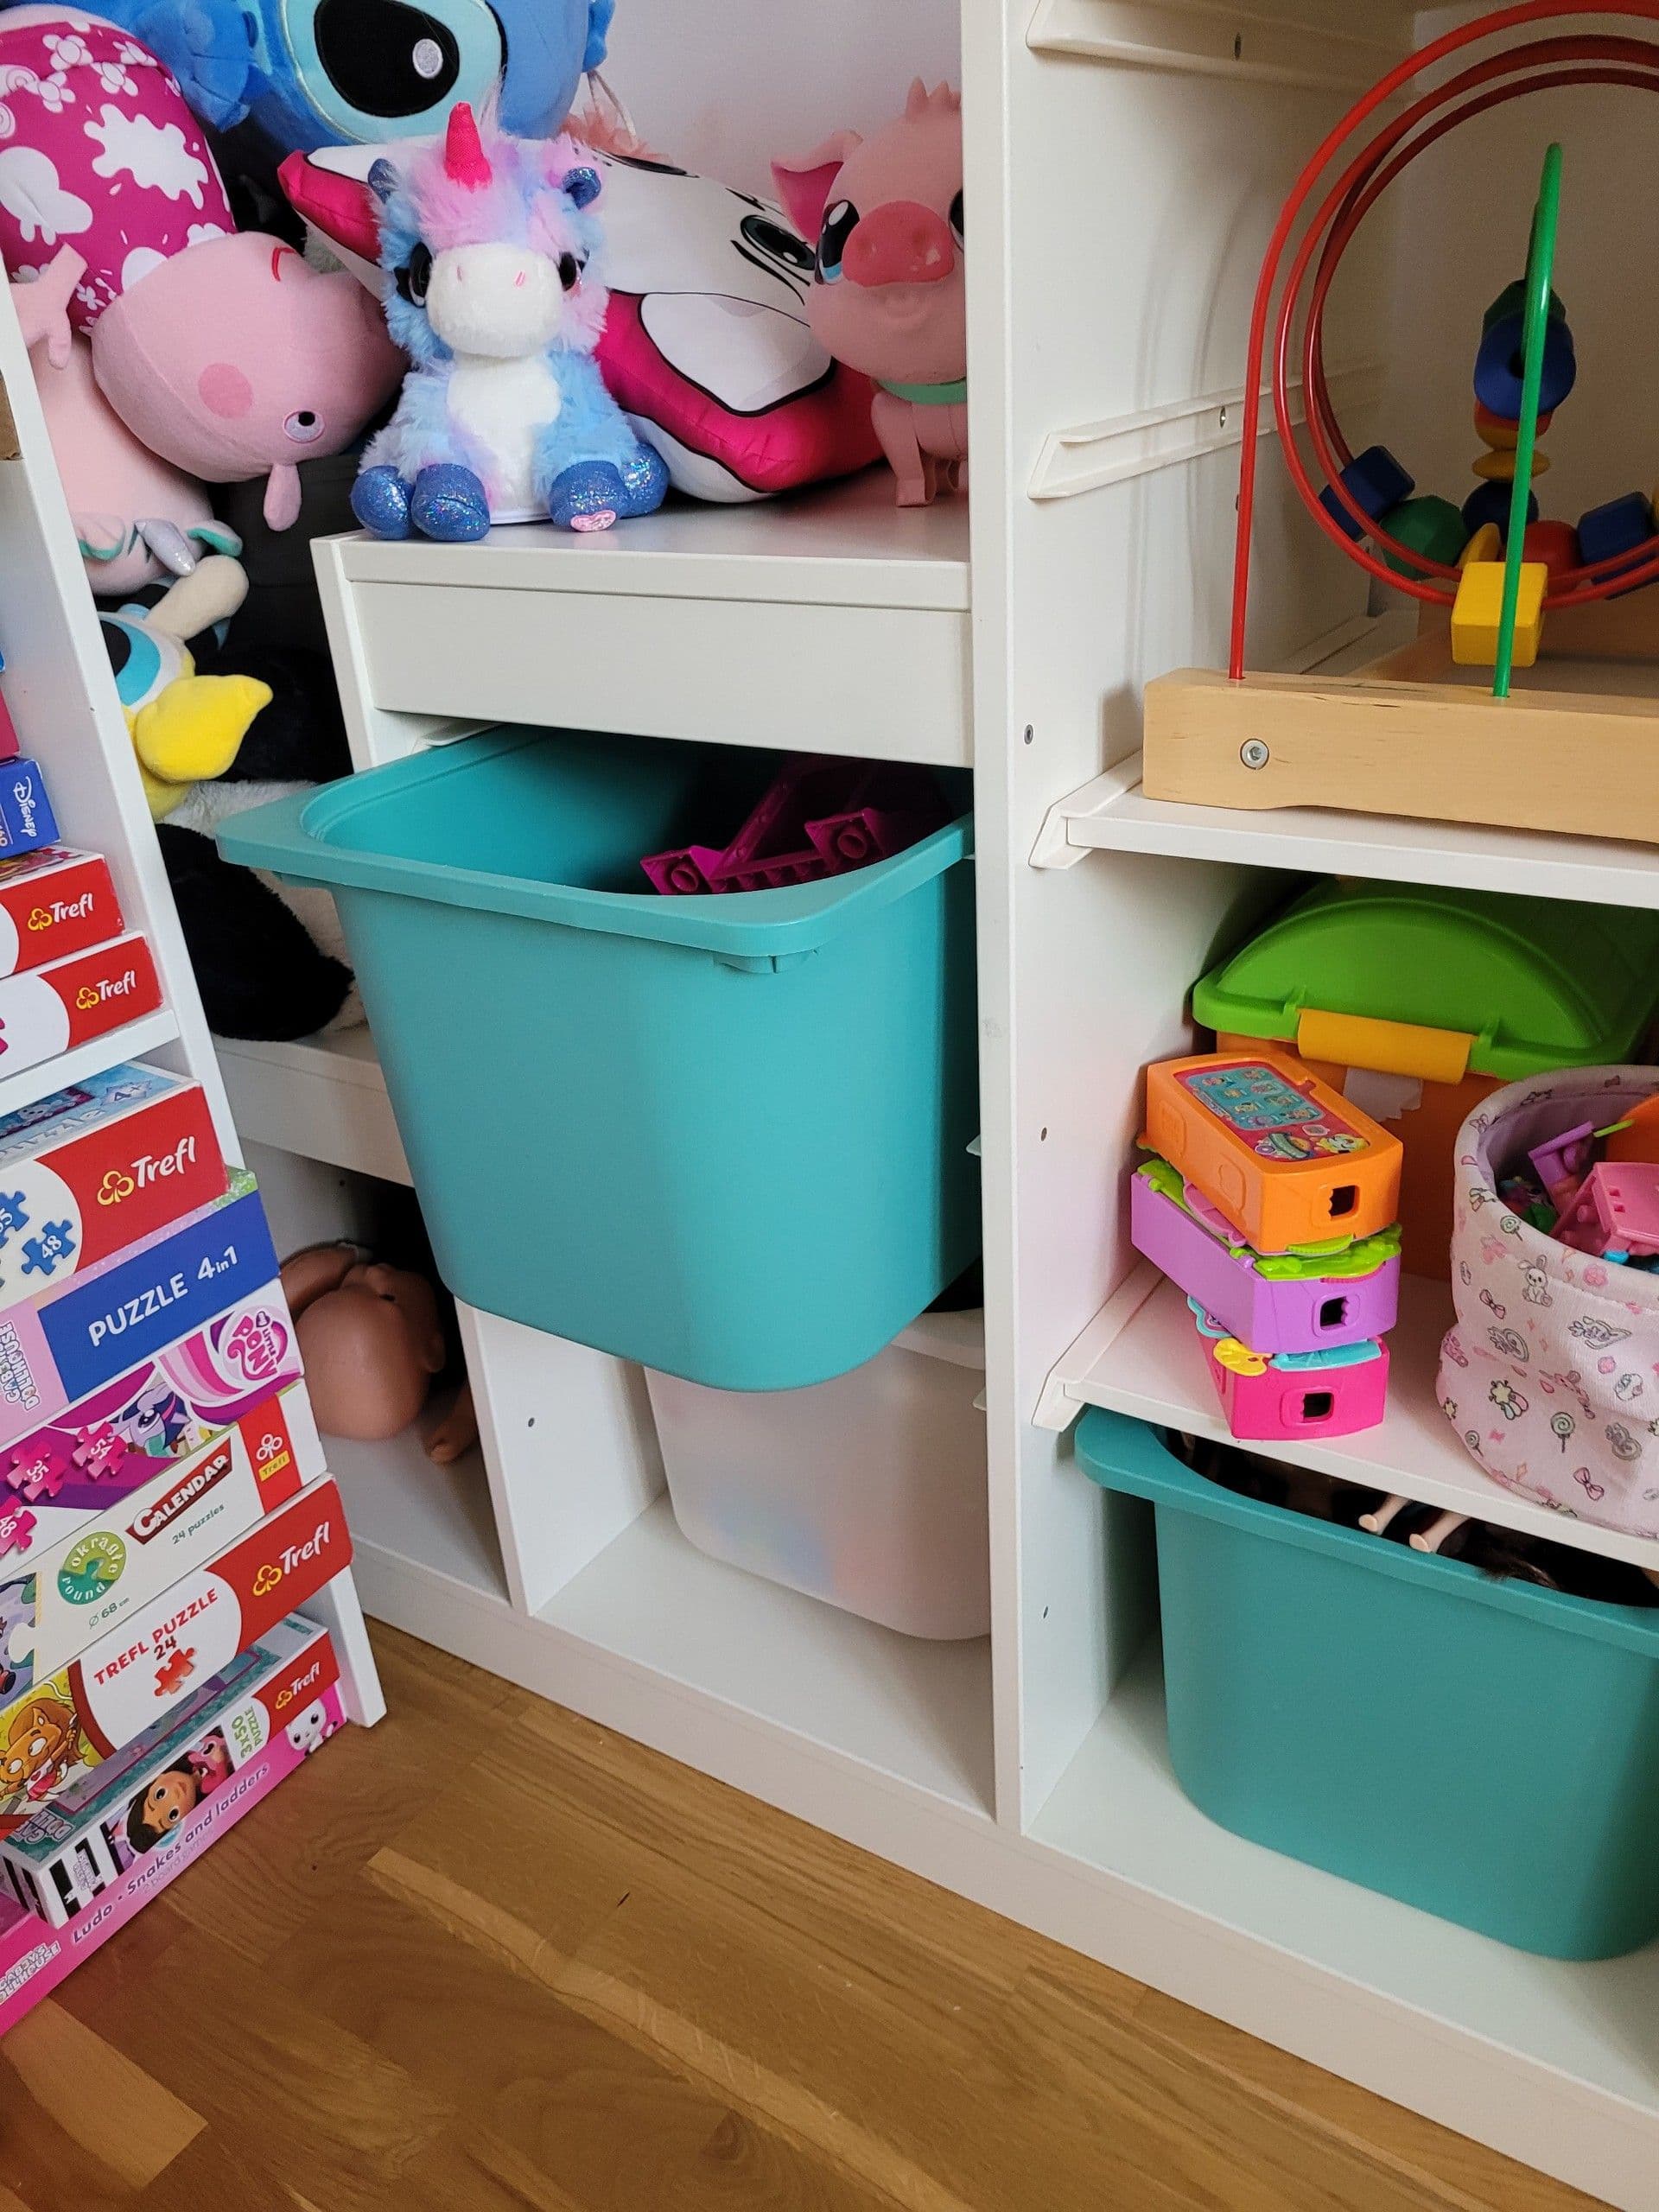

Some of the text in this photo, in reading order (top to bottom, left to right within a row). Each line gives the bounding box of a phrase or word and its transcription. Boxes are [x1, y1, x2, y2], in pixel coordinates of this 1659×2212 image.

[50, 893, 93, 924] Trefl
[95, 969, 137, 1001] Trefl
[130, 1135, 197, 1188] Trefl
[41, 1234, 62, 1259] 48
[88, 1273, 189, 1347] PUZZLE
[227, 1315, 278, 1381] PONY
[91, 1438, 113, 1460] 54
[27, 1459, 50, 1483] 35
[133, 1454, 230, 1536] CALENDAR
[172, 1504, 225, 1545] 24 puzzles
[279, 1522, 331, 1575] Trefl
[94, 1588, 218, 1686] TREFL PUZZLE
[154, 1635, 177, 1661] 24
[290, 1661, 321, 1695] Trefl
[245, 1705, 264, 1747] PUZZLE
[73, 1903, 113, 1943] Ludo
[127, 1842, 181, 1896] Snakes
[185, 1809, 213, 1843] and
[216, 1765, 268, 1816] ladders
[0, 1942, 60, 2002] OLLHOUSE
